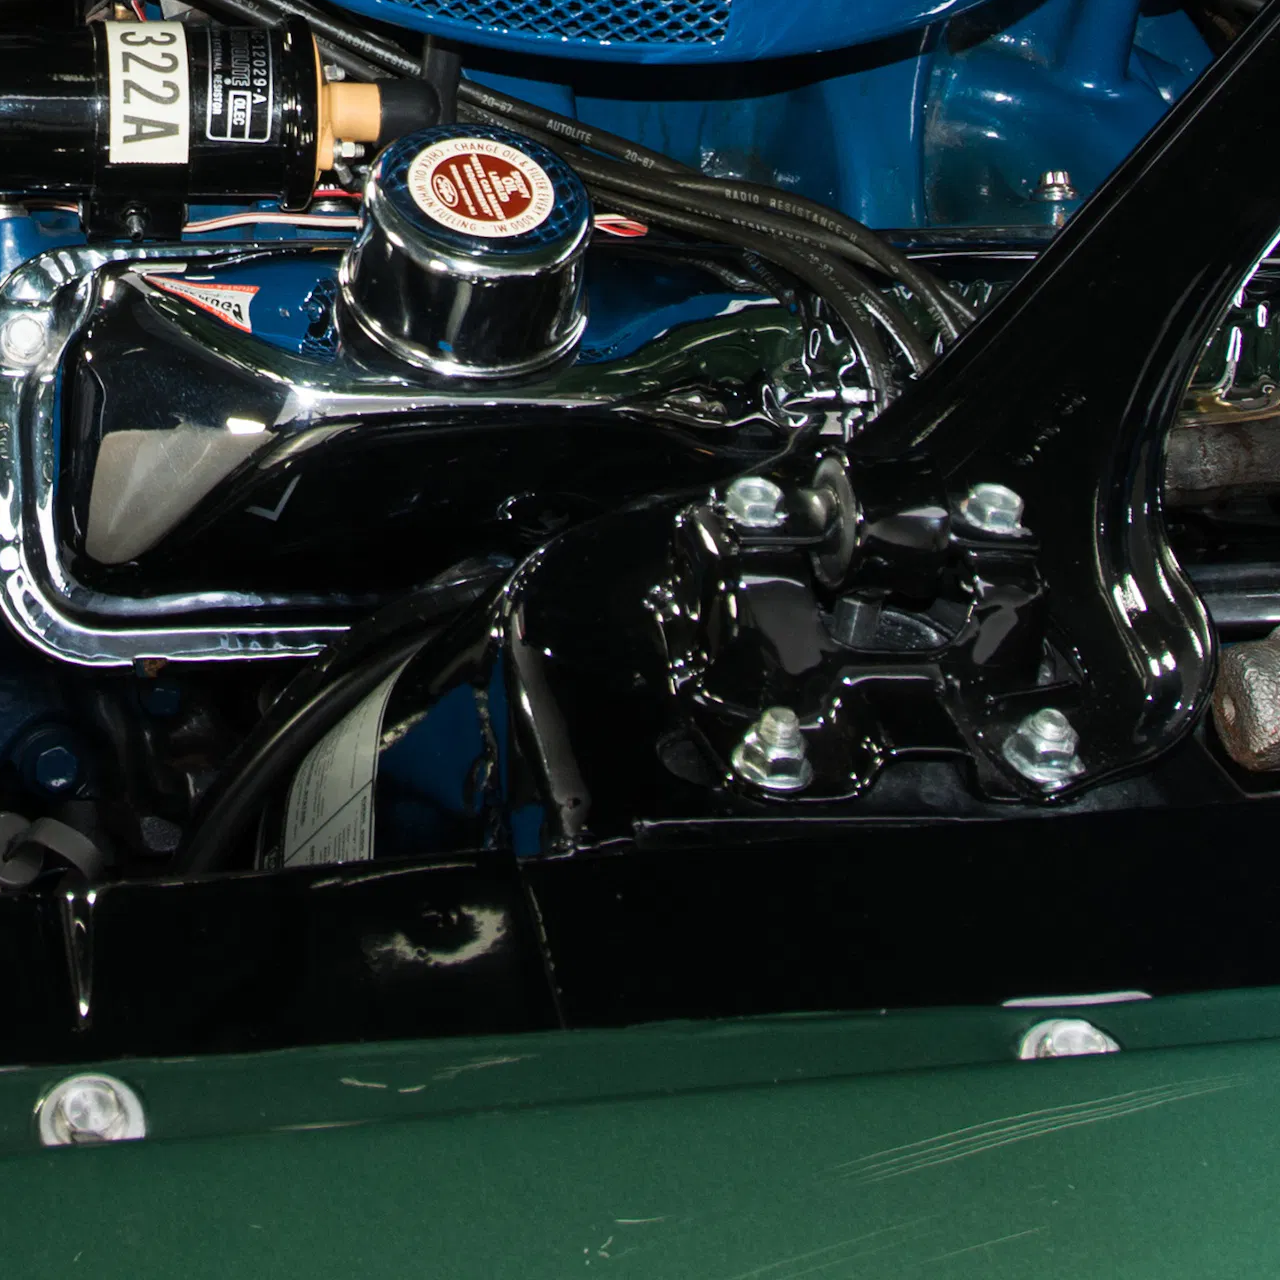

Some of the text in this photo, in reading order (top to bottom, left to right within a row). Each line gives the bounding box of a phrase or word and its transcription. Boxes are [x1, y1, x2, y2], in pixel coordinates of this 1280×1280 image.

[119, 31, 181, 144] 322A
[212, 73, 223, 116] RESISTOR
[454, 142, 498, 155] CHANGE
[502, 149, 518, 163] OIL
[546, 119, 593, 145] AUTOLITE
[724, 187, 761, 204] RADIO
[414, 149, 477, 231] CHECK OIL WHEN FUELING
[501, 176, 518, 195] OIL
[528, 167, 545, 194] FILTER
[535, 193, 550, 217] EVERY
[511, 215, 538, 231] 6000
